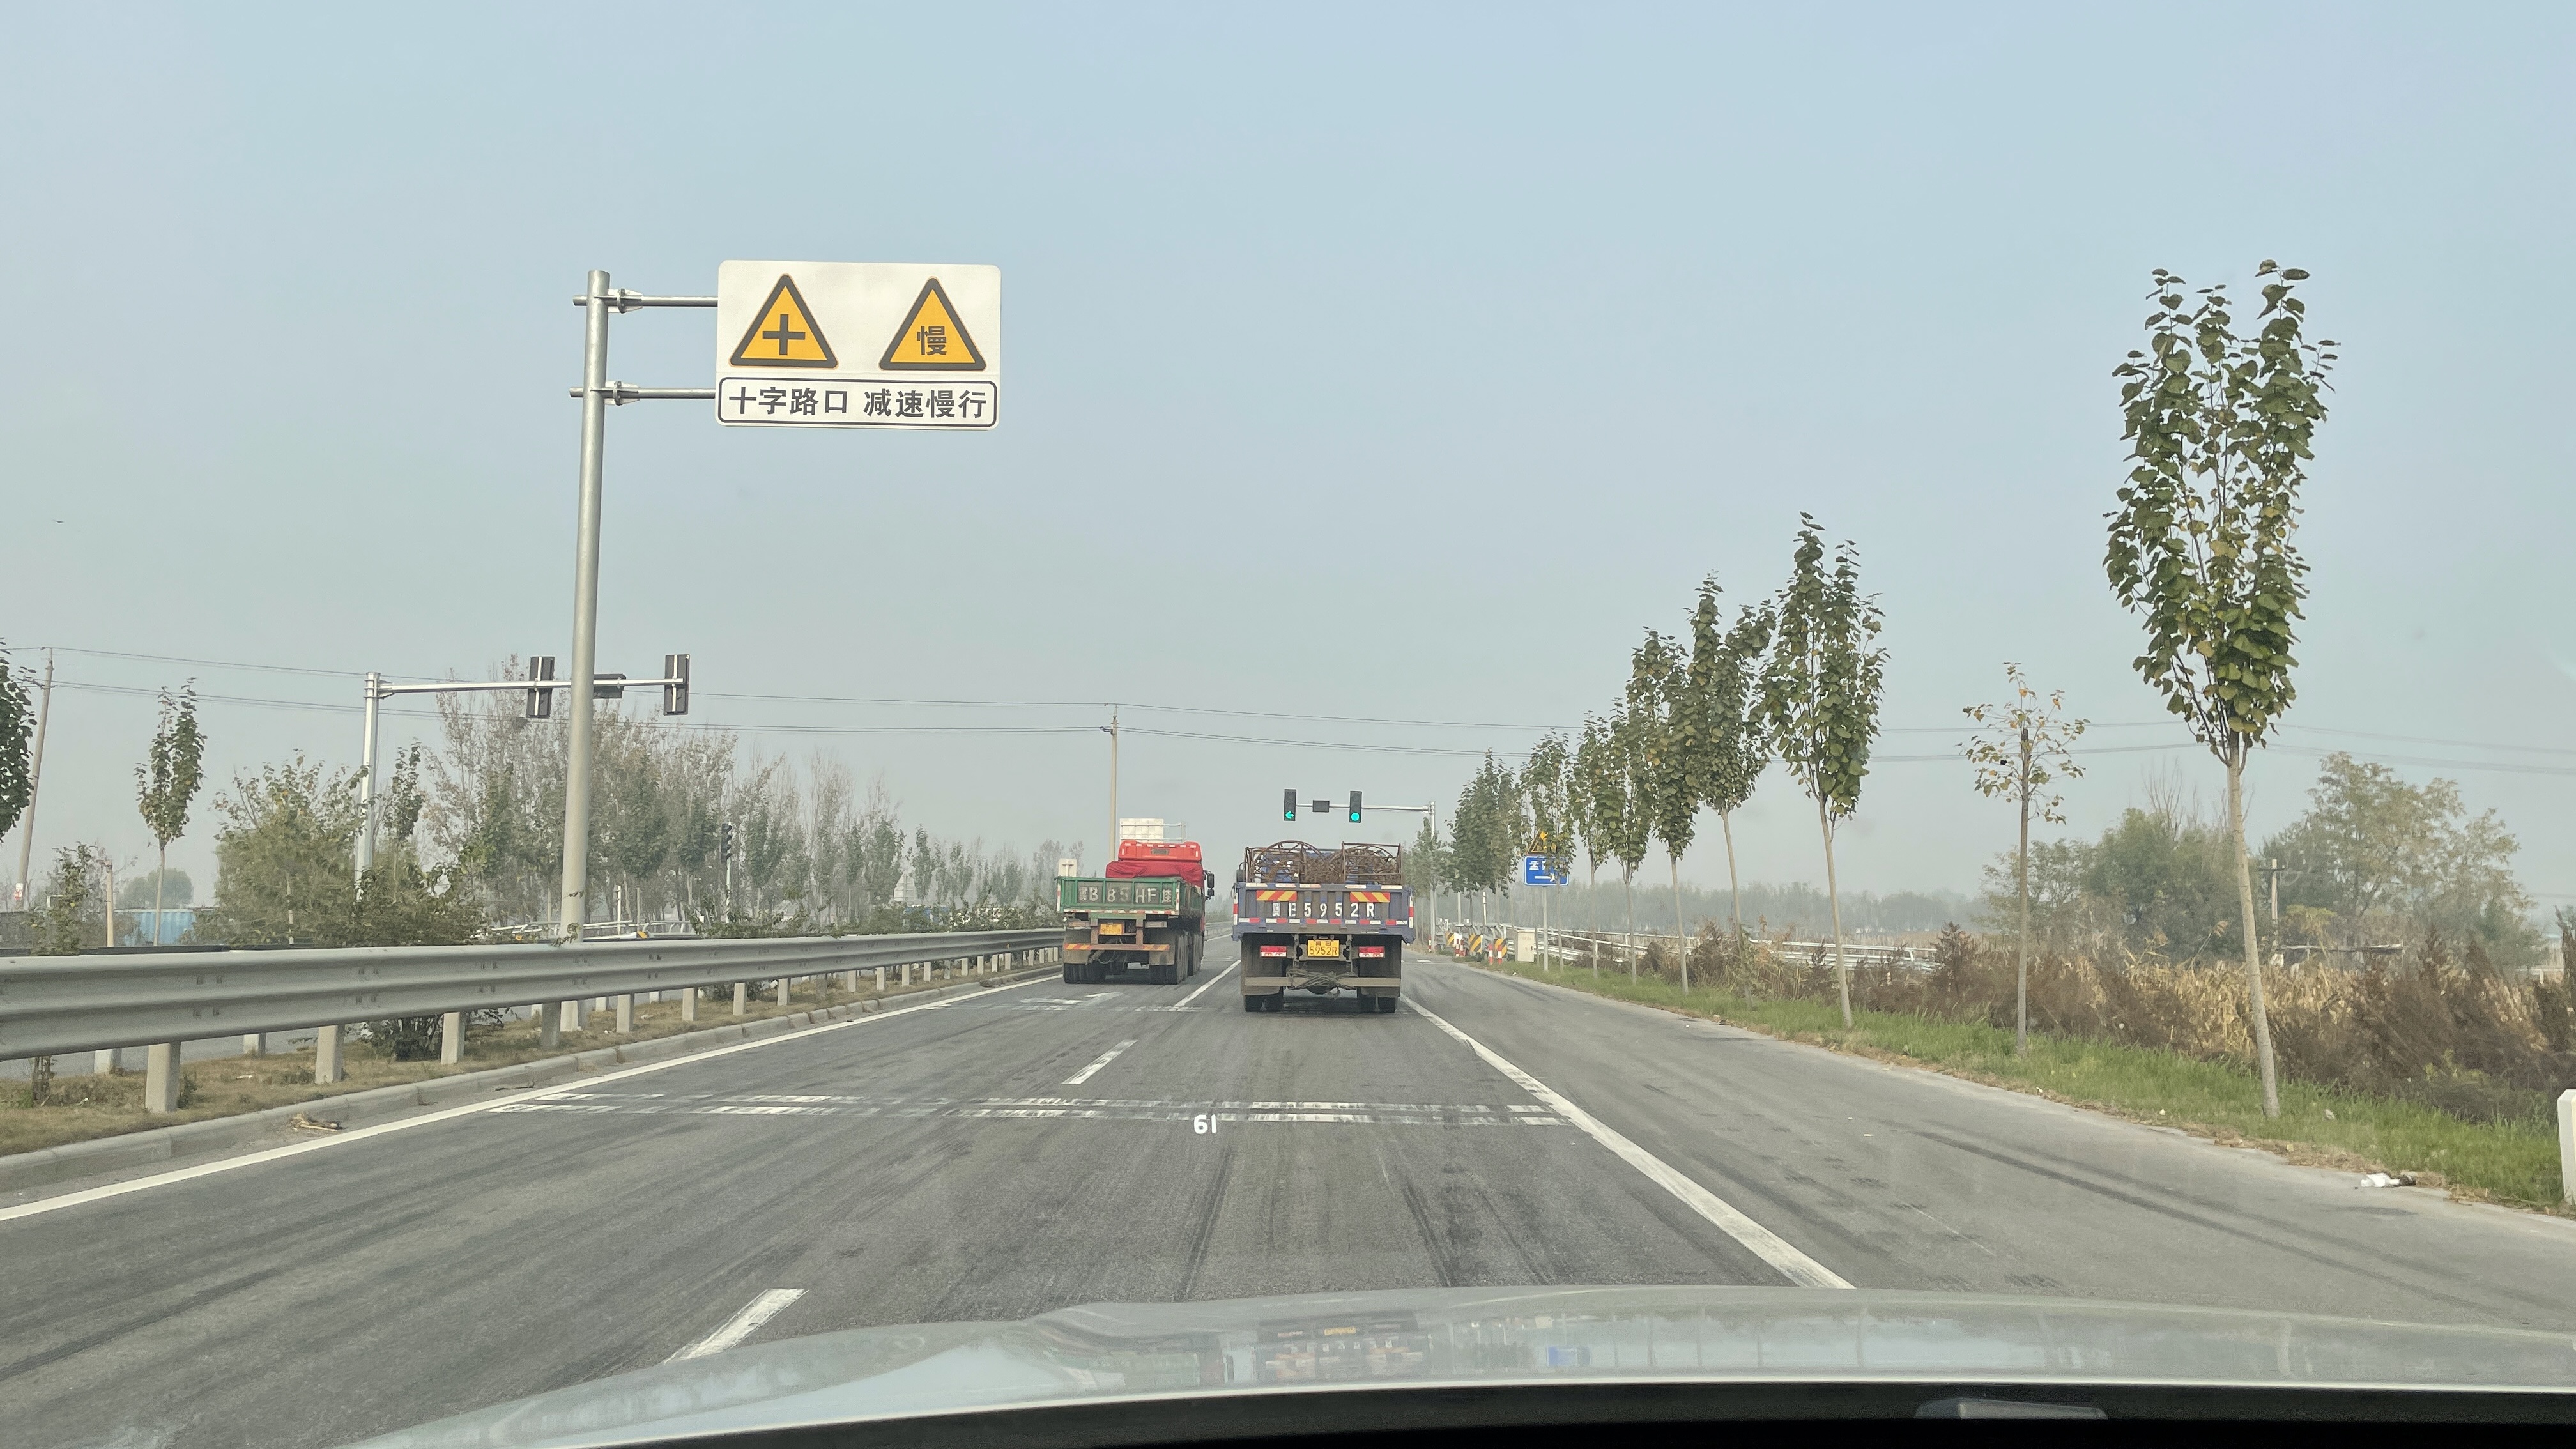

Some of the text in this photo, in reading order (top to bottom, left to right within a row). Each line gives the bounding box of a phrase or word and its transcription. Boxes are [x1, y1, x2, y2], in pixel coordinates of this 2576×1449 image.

[917, 325, 947, 356] 慢
[729, 387, 987, 418] 十字路口 减速慢行
[1309, 946, 1337, 956] 5952R
[1193, 1114, 1217, 1135] 61
